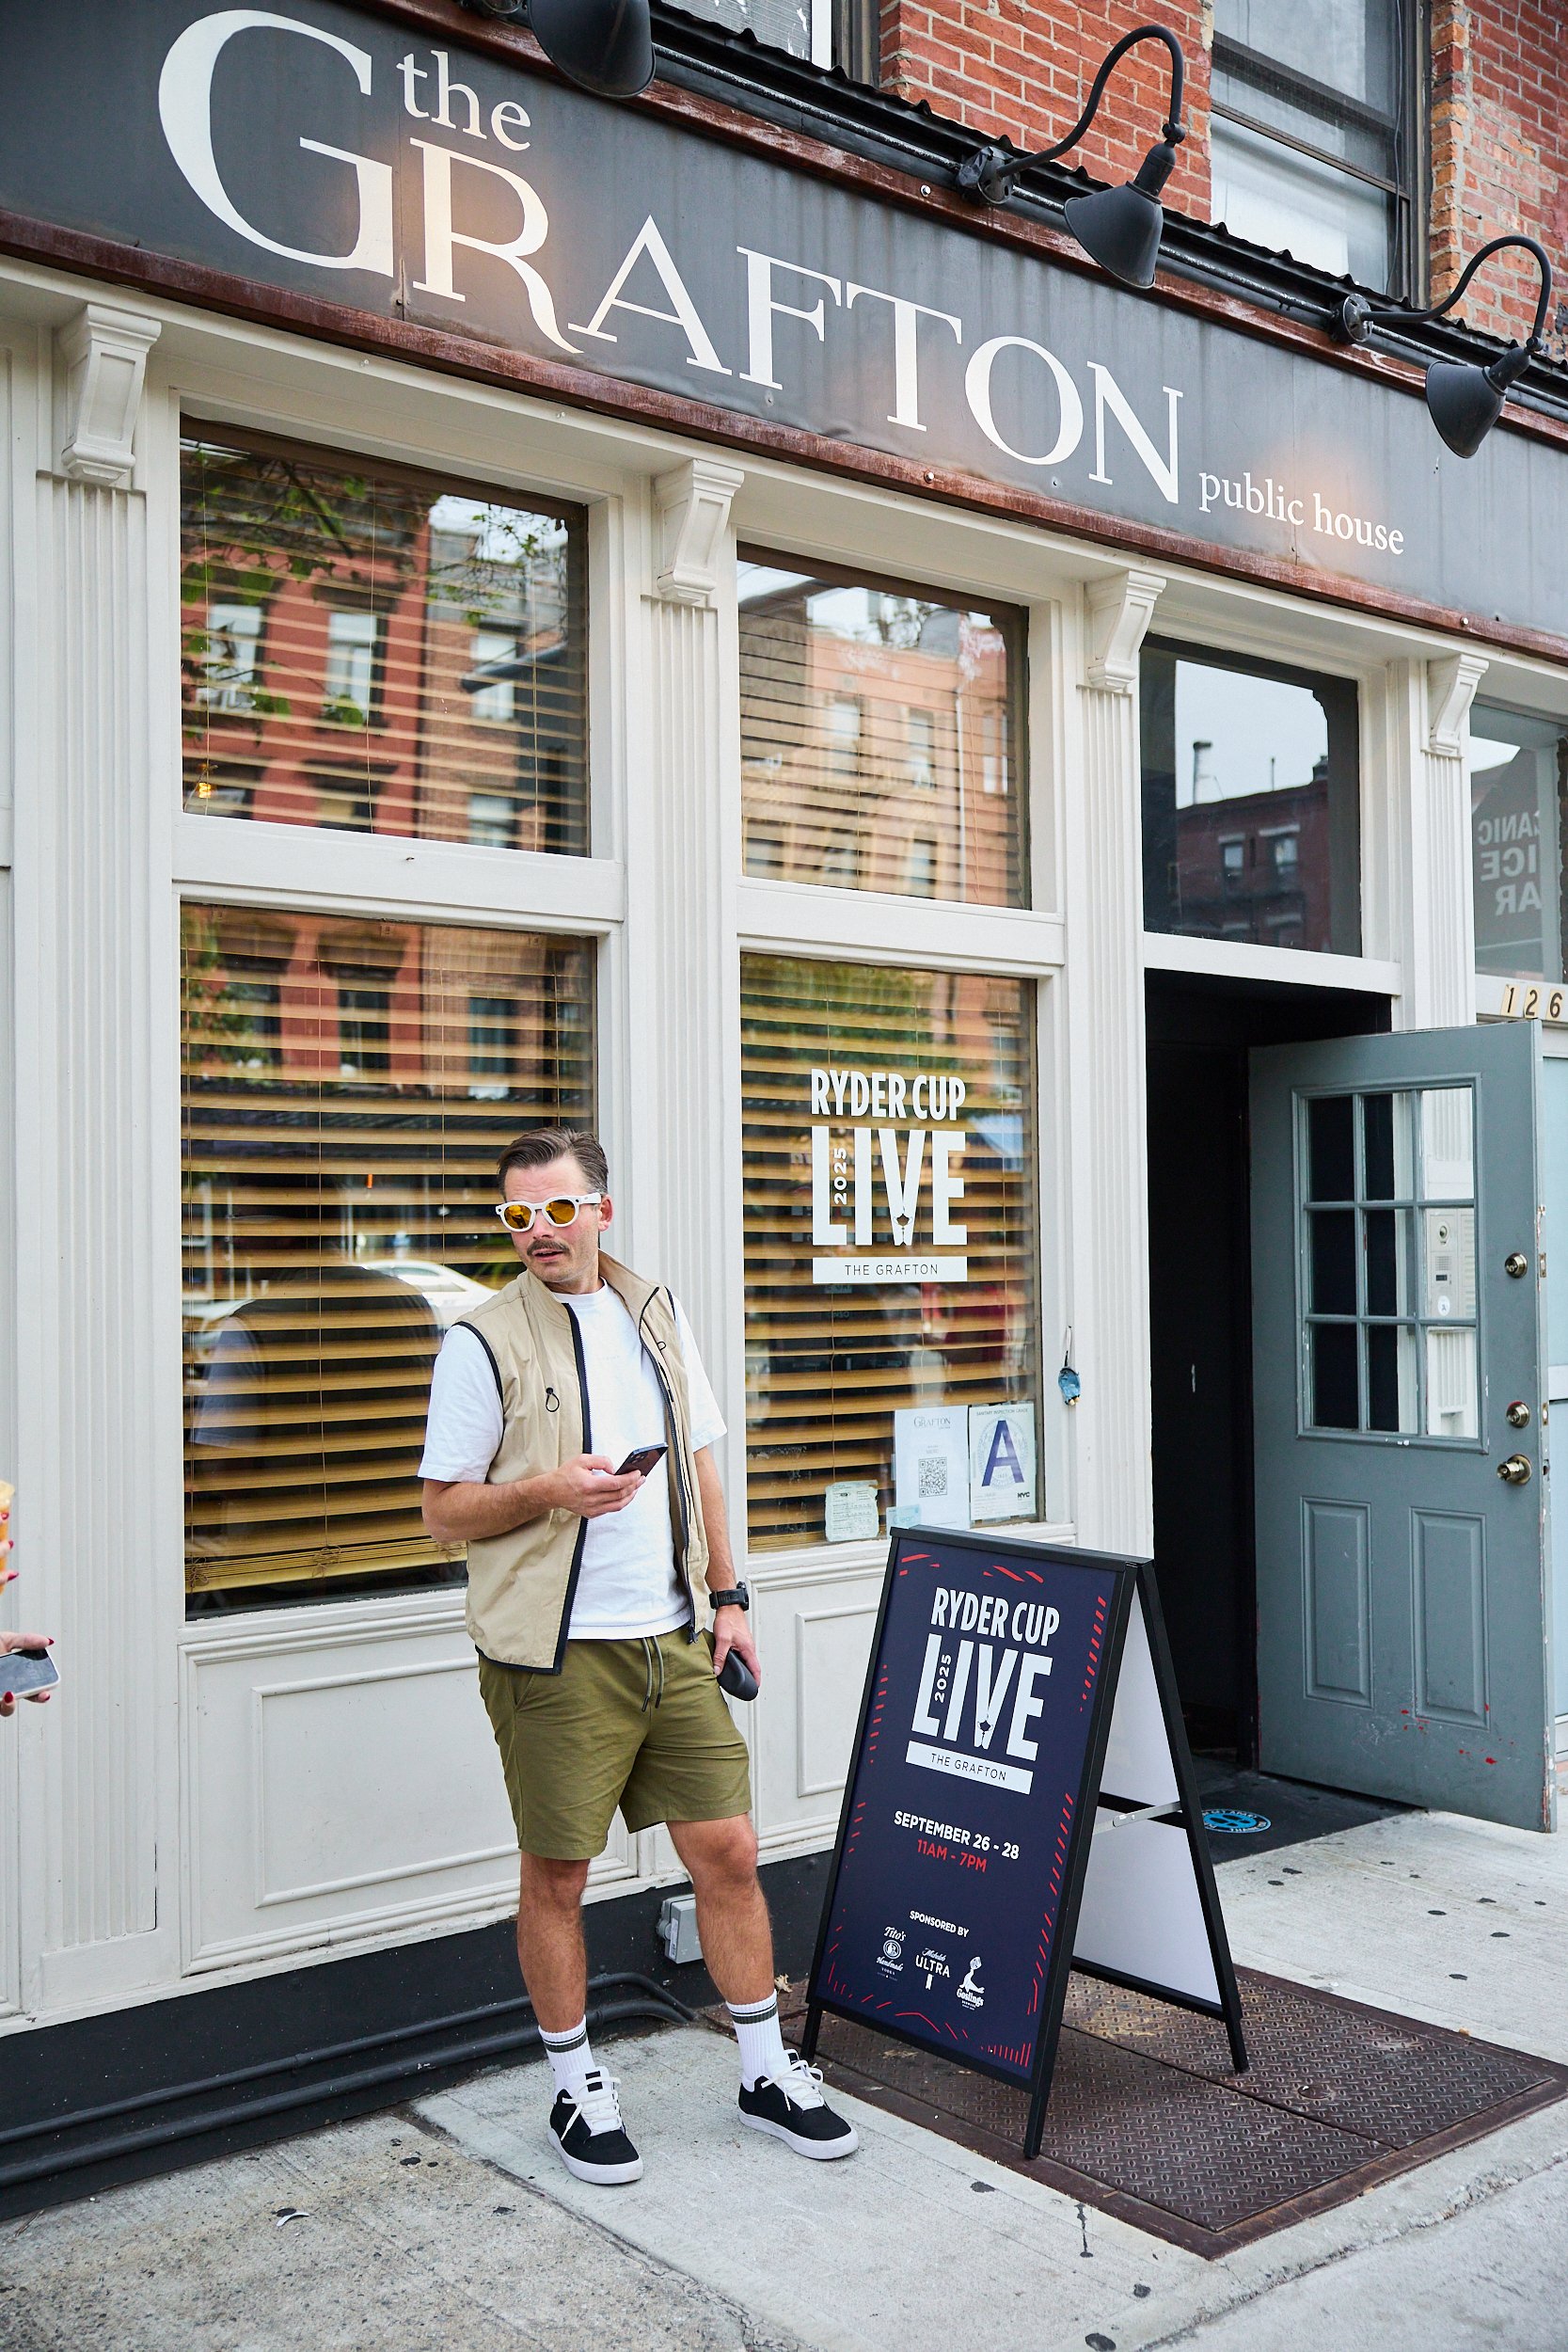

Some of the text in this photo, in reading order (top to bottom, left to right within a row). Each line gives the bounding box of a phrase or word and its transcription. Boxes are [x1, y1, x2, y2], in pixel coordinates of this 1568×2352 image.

[396, 50, 531, 151] the
[158, 9, 1183, 504] GRAFTON
[1198, 471, 1404, 555] public house
[1507, 987, 1563, 1018] 126
[811, 1068, 966, 1120] RYDER CUP
[812, 1125, 968, 1246] LIVE
[833, 1147, 847, 1205] 2025
[845, 1263, 939, 1276] THE GRAFTON
[981, 1420, 1025, 1487] A
[930, 1586, 1060, 1646] RYDER CUP
[911, 1632, 1053, 1761] LIVE
[934, 1654, 952, 1704] 2025
[931, 1753, 1006, 1781] THE GRAFTON
[894, 1810, 971, 1846] SEPTEMBER
[973, 1833, 990, 1851] 26
[1001, 1841, 1020, 1860] 28
[917, 1838, 948, 1861] 11AM
[959, 1851, 988, 1873] 7PM
[884, 1926, 907, 1942] Tito's
[910, 1910, 970, 1938] SPONSORED BY
[915, 1955, 950, 1978] ULTRA
[957, 1988, 985, 2008] Goslings
